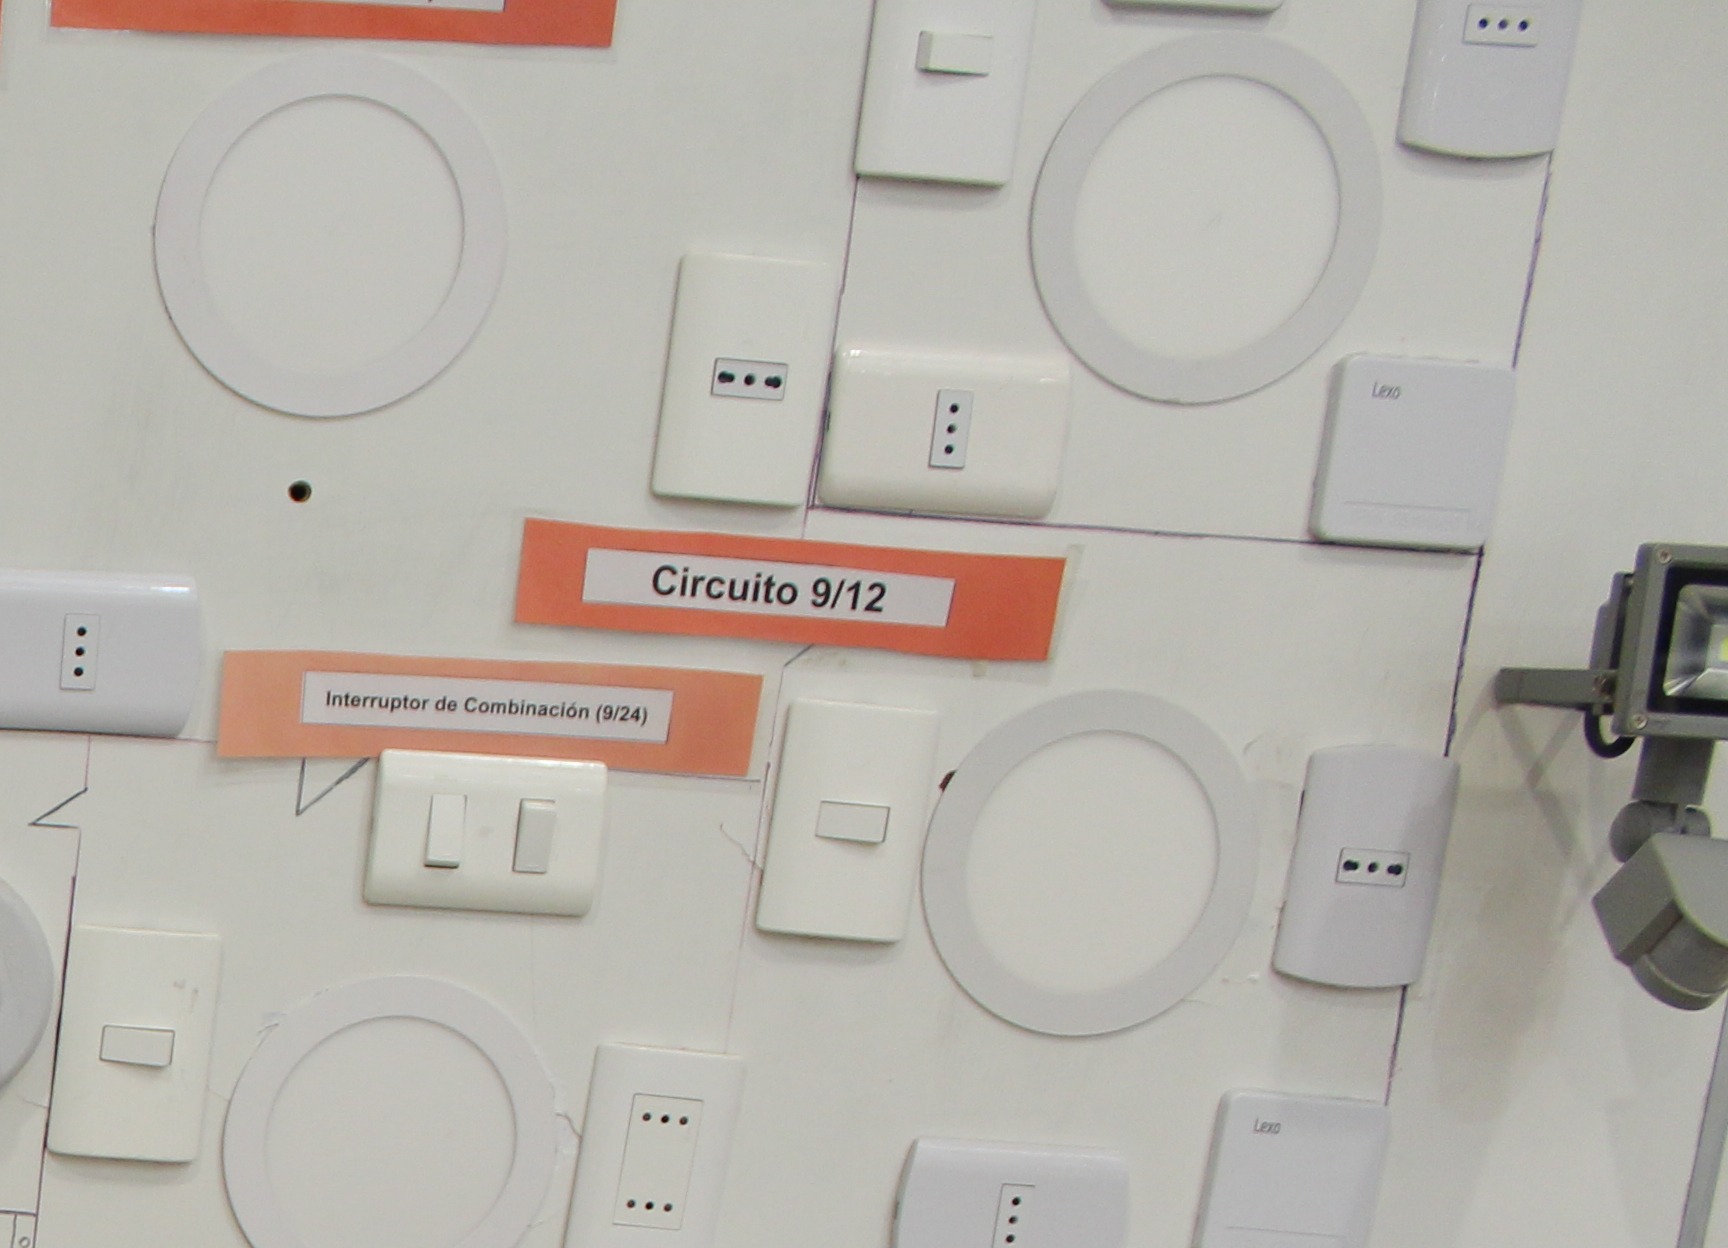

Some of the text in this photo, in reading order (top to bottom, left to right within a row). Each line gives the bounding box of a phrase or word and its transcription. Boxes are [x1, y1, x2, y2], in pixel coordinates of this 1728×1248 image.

[1371, 381, 1401, 400] Lexo
[652, 564, 888, 613] Circuito 9/12
[325, 690, 649, 727] Interruptor de Combinación (9/24)
[1254, 1117, 1281, 1135] Lexo
